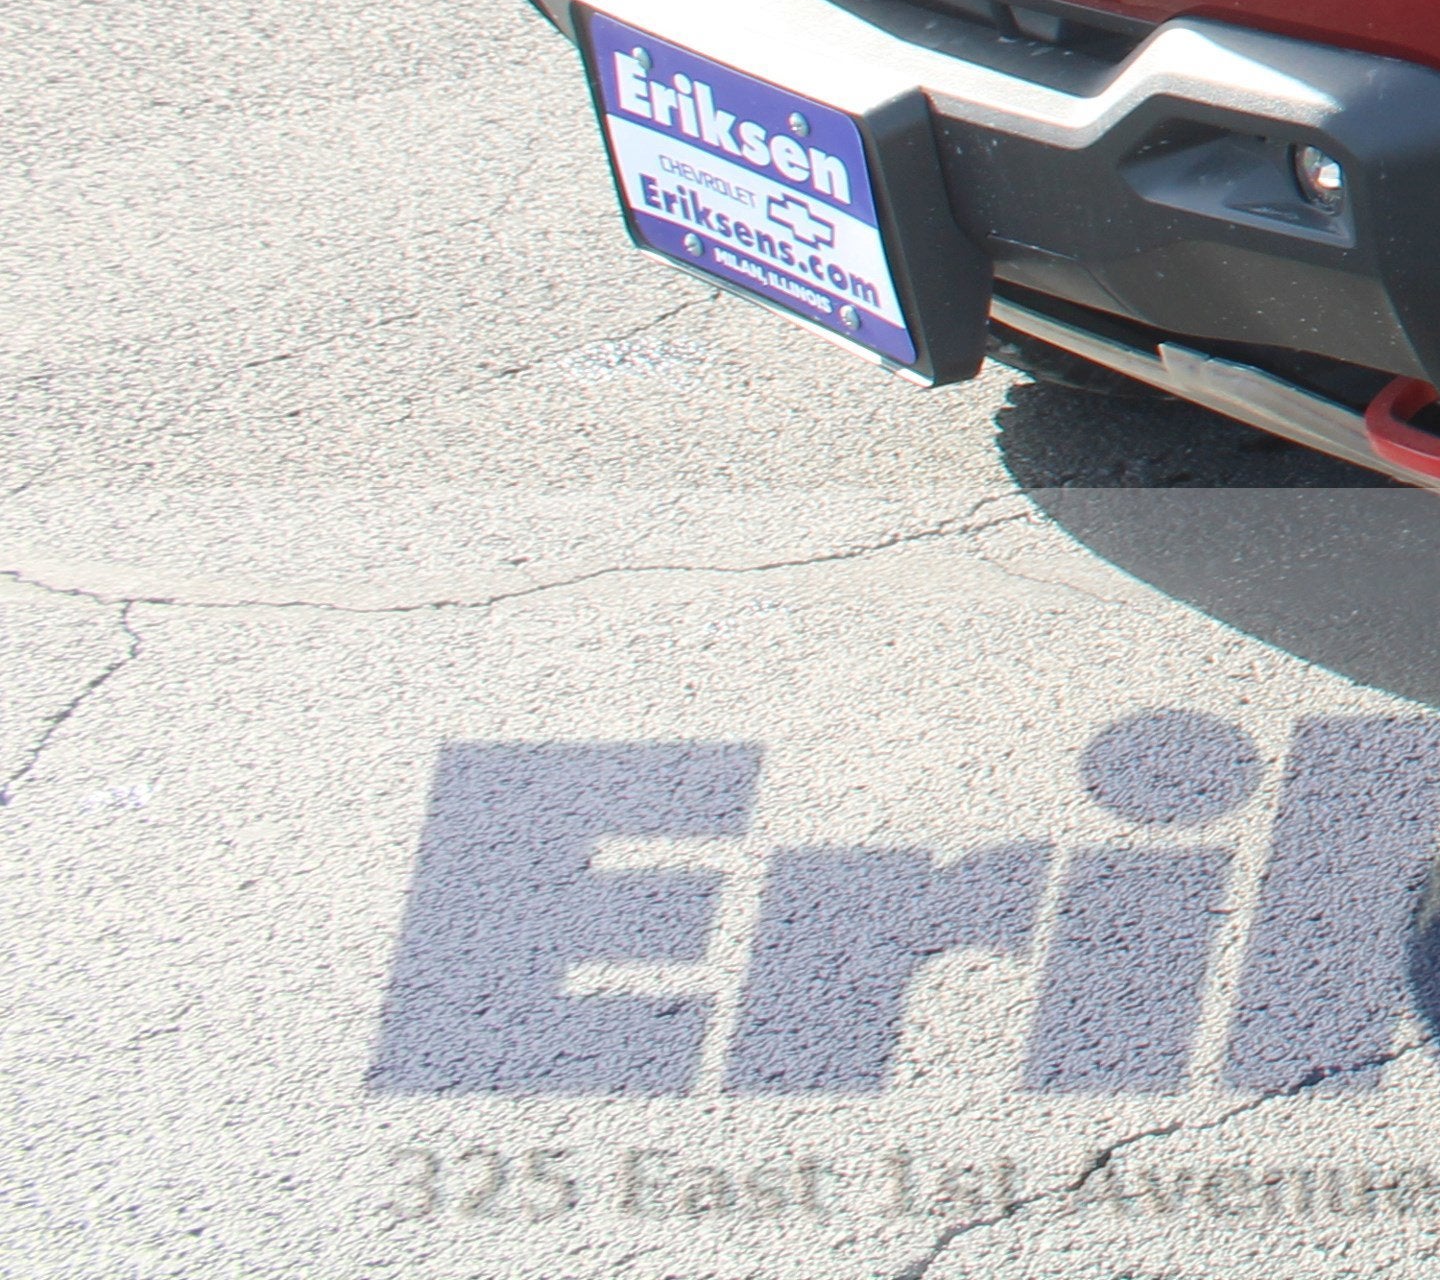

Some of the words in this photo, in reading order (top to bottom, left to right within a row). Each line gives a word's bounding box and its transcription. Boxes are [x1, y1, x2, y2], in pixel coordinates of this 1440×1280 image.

[614, 51, 851, 205] Eriksen
[658, 154, 757, 208] CHEVROLET
[639, 172, 881, 308] Eriksens.com
[713, 246, 767, 286] MILAN,
[767, 268, 834, 313] ILLINOIS
